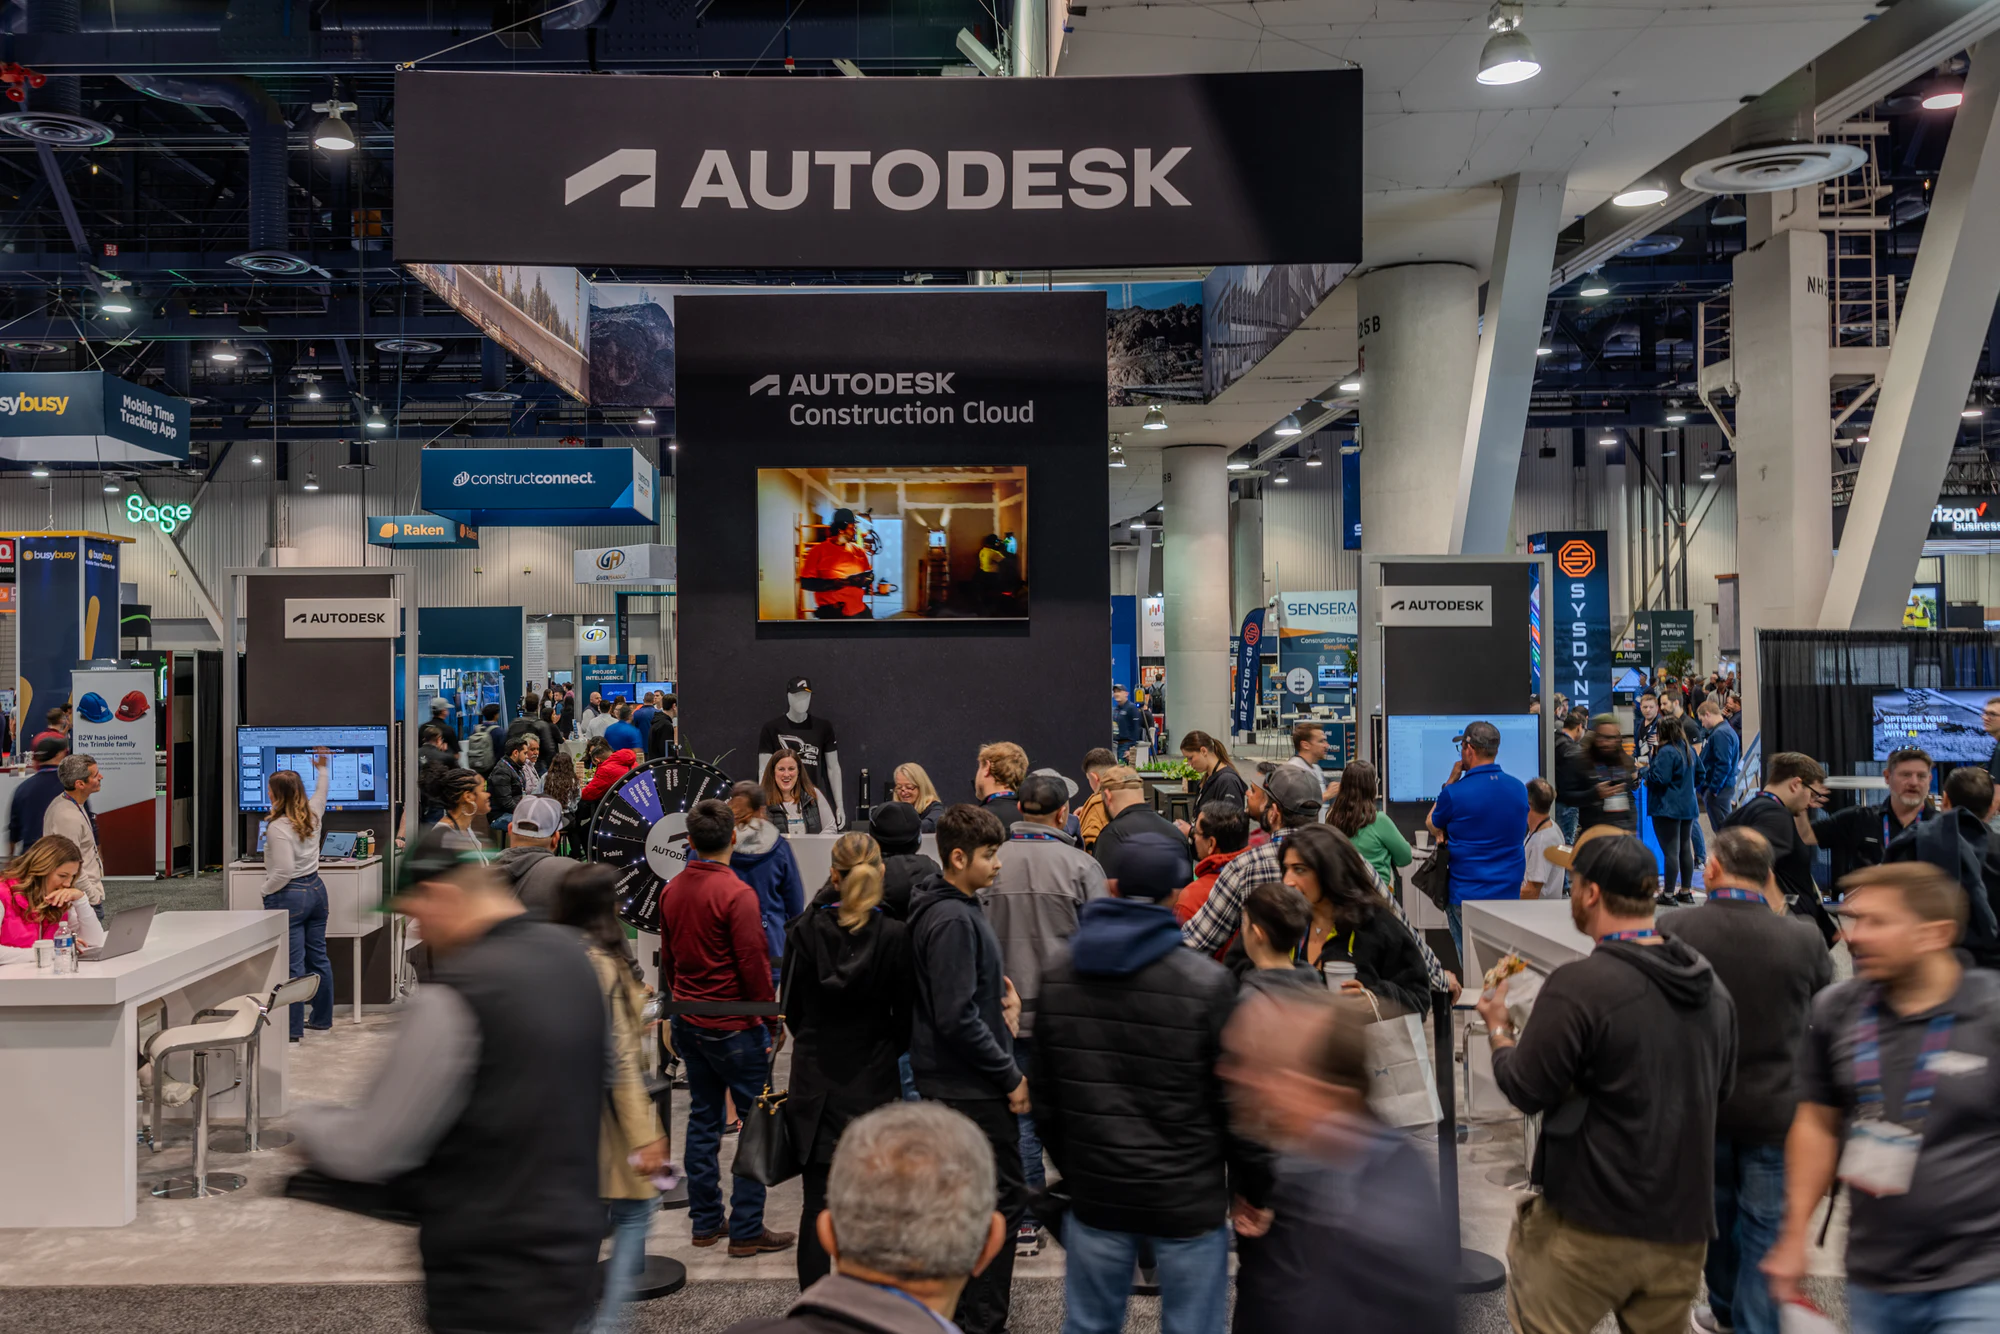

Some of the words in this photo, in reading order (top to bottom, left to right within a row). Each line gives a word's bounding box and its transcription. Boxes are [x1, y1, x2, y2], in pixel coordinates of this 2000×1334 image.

[682, 146, 1193, 211] AUTODESK
[788, 372, 956, 396] AUTODESK
[123, 394, 152, 416] Mobile
[153, 404, 175, 424] Time
[789, 401, 955, 426] Construction
[962, 400, 1034, 424] Cloud
[120, 408, 158, 435] Tracking
[159, 424, 177, 440] App
[126, 494, 192, 534] Sage
[403, 524, 445, 536] Raken
[34, 550, 76, 561] busybusy
[1287, 601, 1357, 616] SENSERA
[1408, 600, 1484, 611] AUTODESK
[310, 613, 386, 623] AUTODESK
[1668, 629, 1685, 637] Align
[1624, 651, 1641, 661] Align
[1240, 646, 1254, 721] SYSDYNE
[1883, 715, 1923, 723] OPTIMIZE
[1924, 715, 1948, 723] YOUR
[1883, 722, 1900, 730] MIX
[1901, 722, 1938, 730] DESIGNS
[107, 734, 128, 742] joined
[628, 787, 640, 803] Cards
[633, 783, 650, 807] Business
[640, 779, 653, 798] Digital
[608, 815, 622, 826] Tape
[610, 809, 640, 827] Measuring
[602, 850, 623, 858] T-shirt
[638, 880, 660, 917] Construction
[644, 901, 657, 920] Pencil
